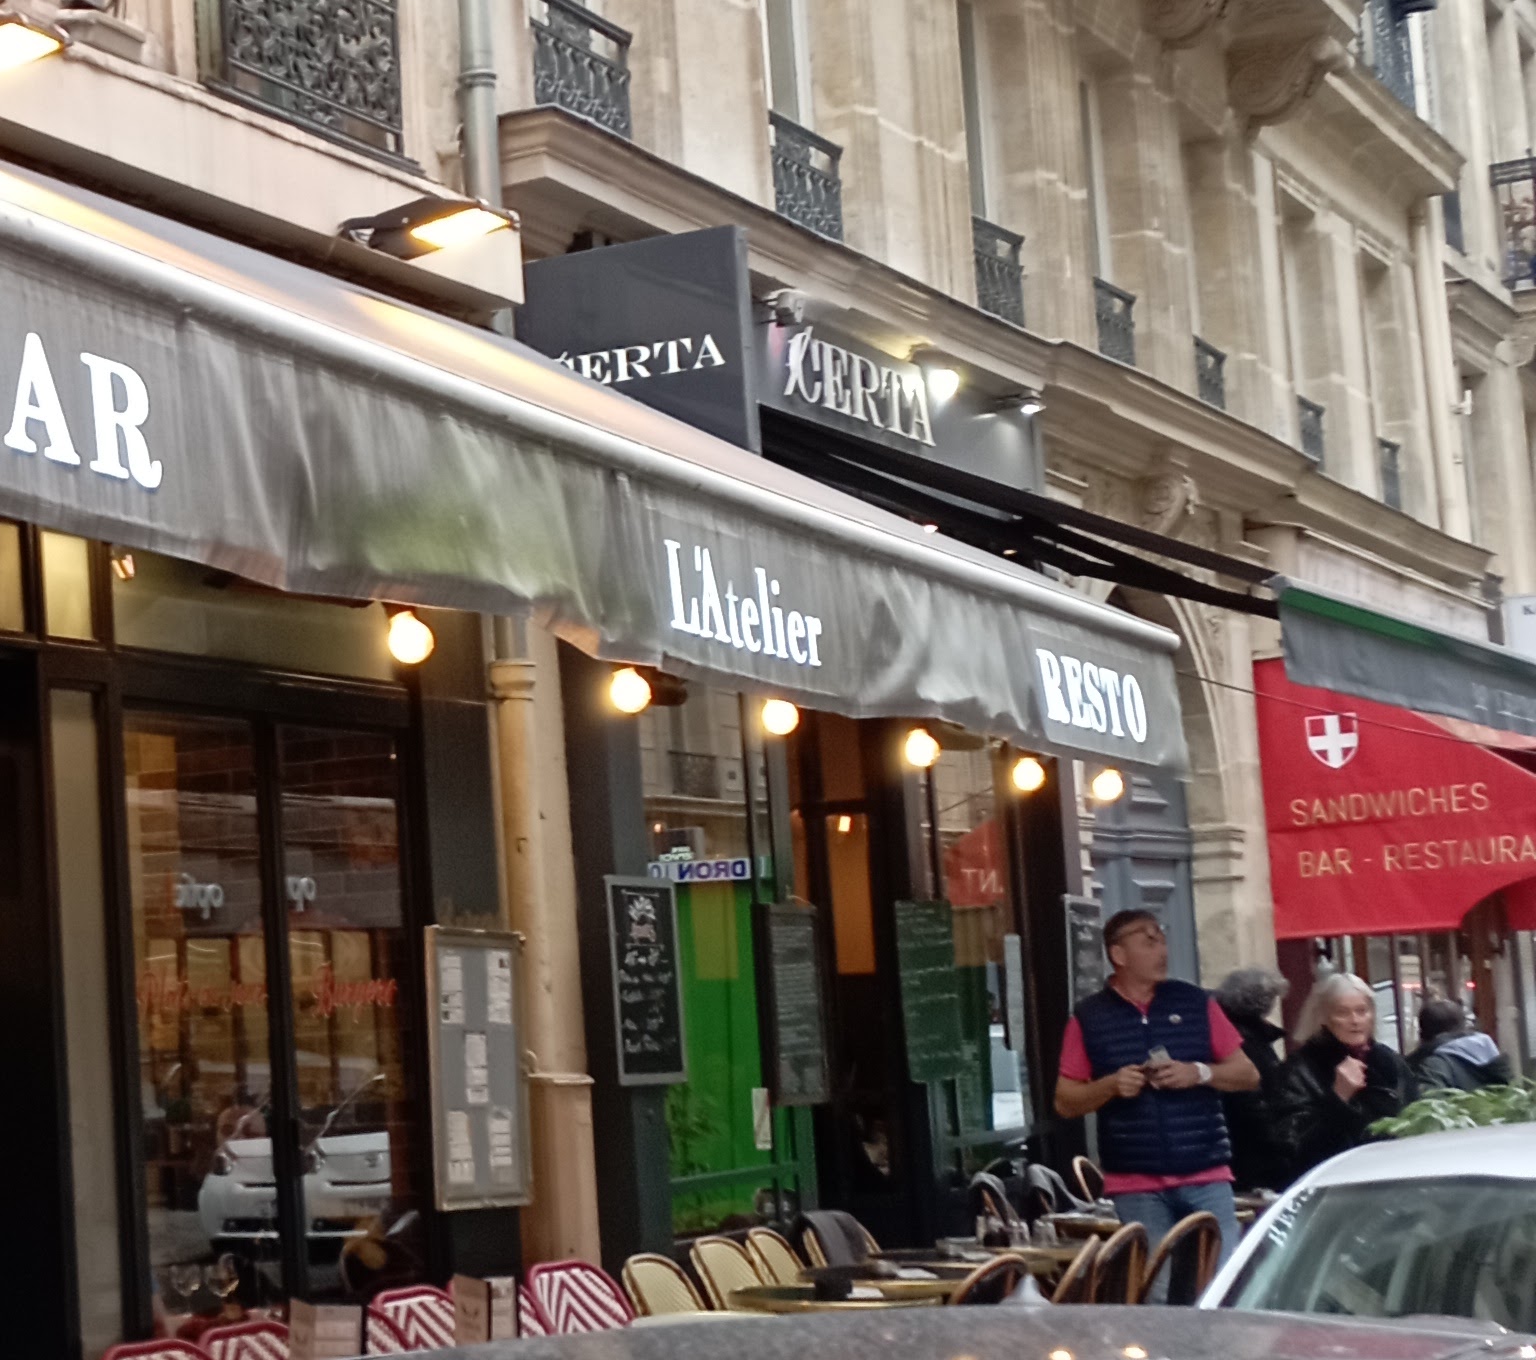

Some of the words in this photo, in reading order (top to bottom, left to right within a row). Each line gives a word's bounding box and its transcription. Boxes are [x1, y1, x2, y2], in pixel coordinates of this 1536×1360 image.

[664, 539, 822, 668] L'Atelier
[1036, 647, 1147, 743] RESTO
[1290, 783, 1490, 827] SANDWICHES
[1298, 848, 1353, 878] BAR
[1383, 835, 1536, 872] RESTAURA
